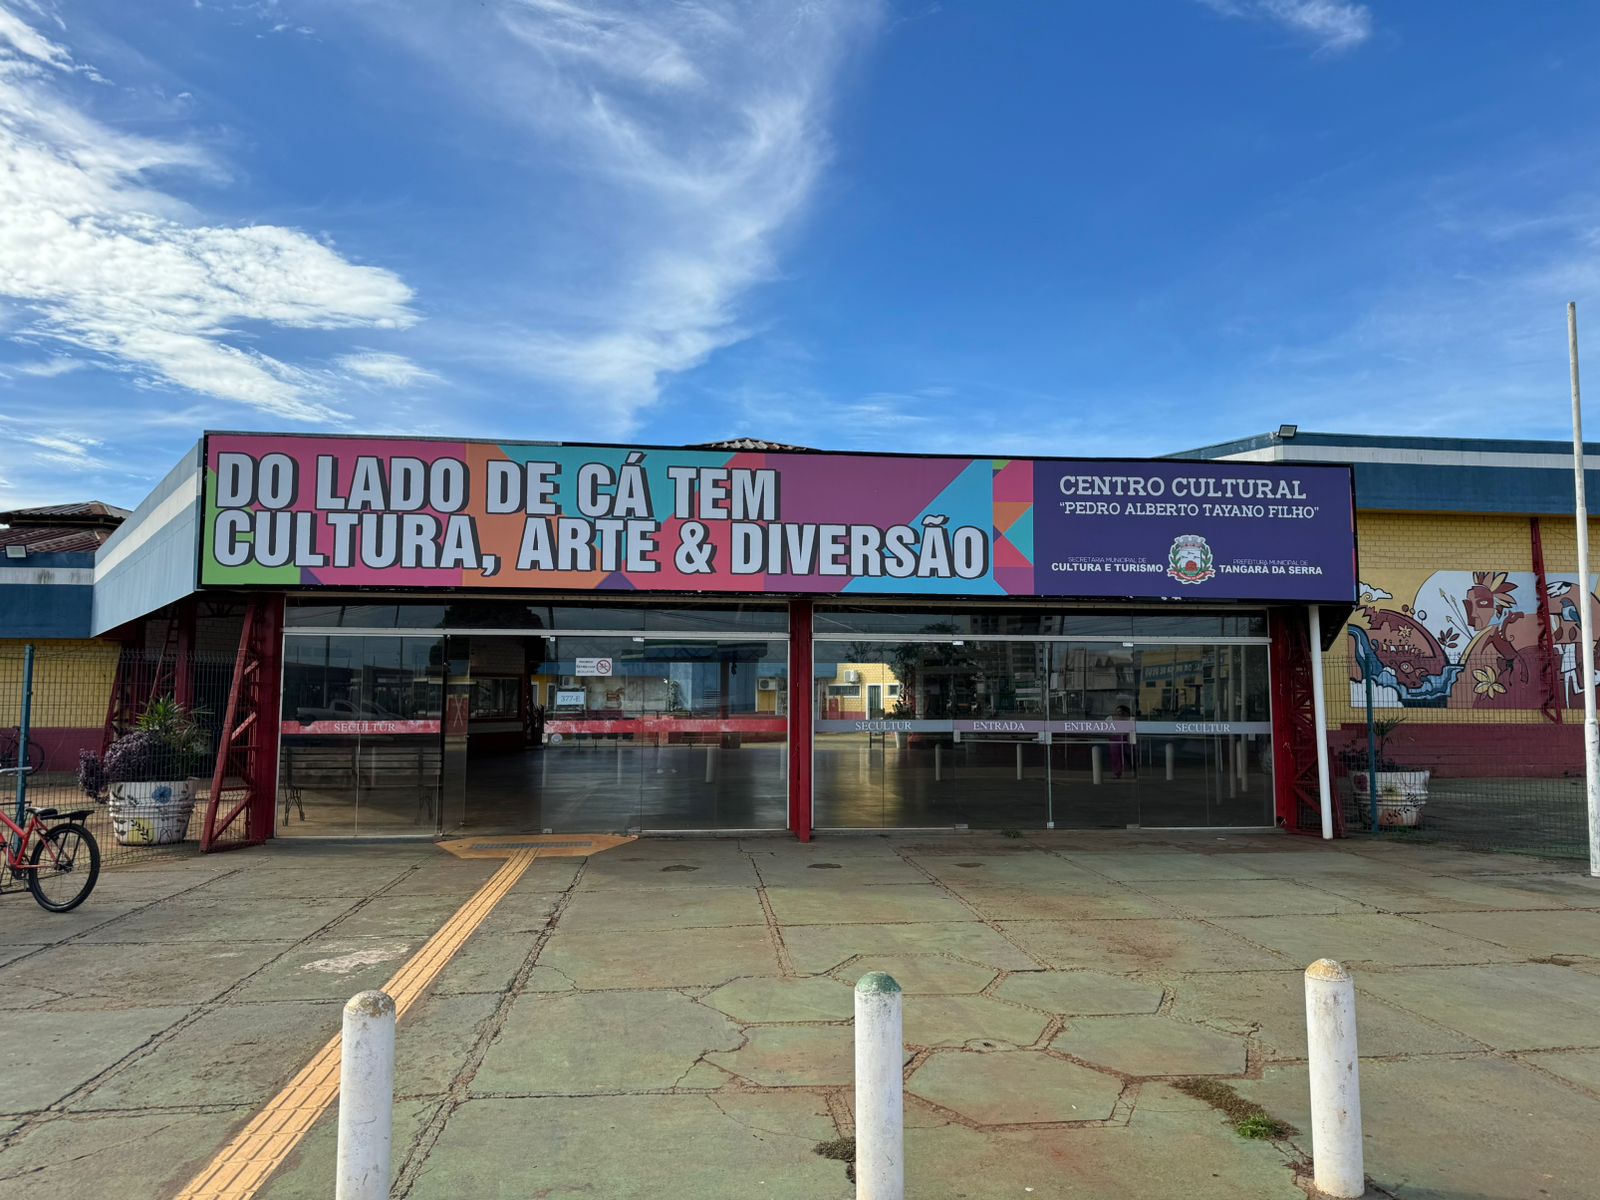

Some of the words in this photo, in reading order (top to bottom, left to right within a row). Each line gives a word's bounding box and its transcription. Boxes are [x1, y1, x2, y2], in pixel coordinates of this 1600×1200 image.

[215, 451, 298, 510] DO
[315, 454, 470, 514] LADO
[485, 459, 562, 516] DE
[577, 451, 654, 520] CÁ
[667, 466, 780, 522] TEM
[1059, 475, 1165, 497] CENTRO
[1171, 477, 1307, 499] CULTURAL
[1059, 502, 1121, 515] "PEDRO
[1125, 502, 1199, 517] ALBERTO
[1203, 503, 1264, 518] TAYANO
[1268, 505, 1319, 519] FILHO"
[213, 508, 500, 577] CULTURA,
[515, 515, 661, 573] ARTE
[674, 520, 717, 575] &
[730, 514, 989, 579] DIVERSÃO
[1051, 562, 1102, 571] CULTURA
[1104, 563, 1111, 572] E
[1114, 563, 1164, 572] TURISMO
[1272, 566, 1286, 574] DA
[1288, 566, 1323, 575] SERRA
[334, 723, 396, 732] SECULTUR
[855, 721, 912, 731] SECULTUR
[973, 721, 1025, 731] ENTRADA
[1064, 722, 1116, 731] ENTRADA
[1175, 723, 1230, 732] SECULTUR
